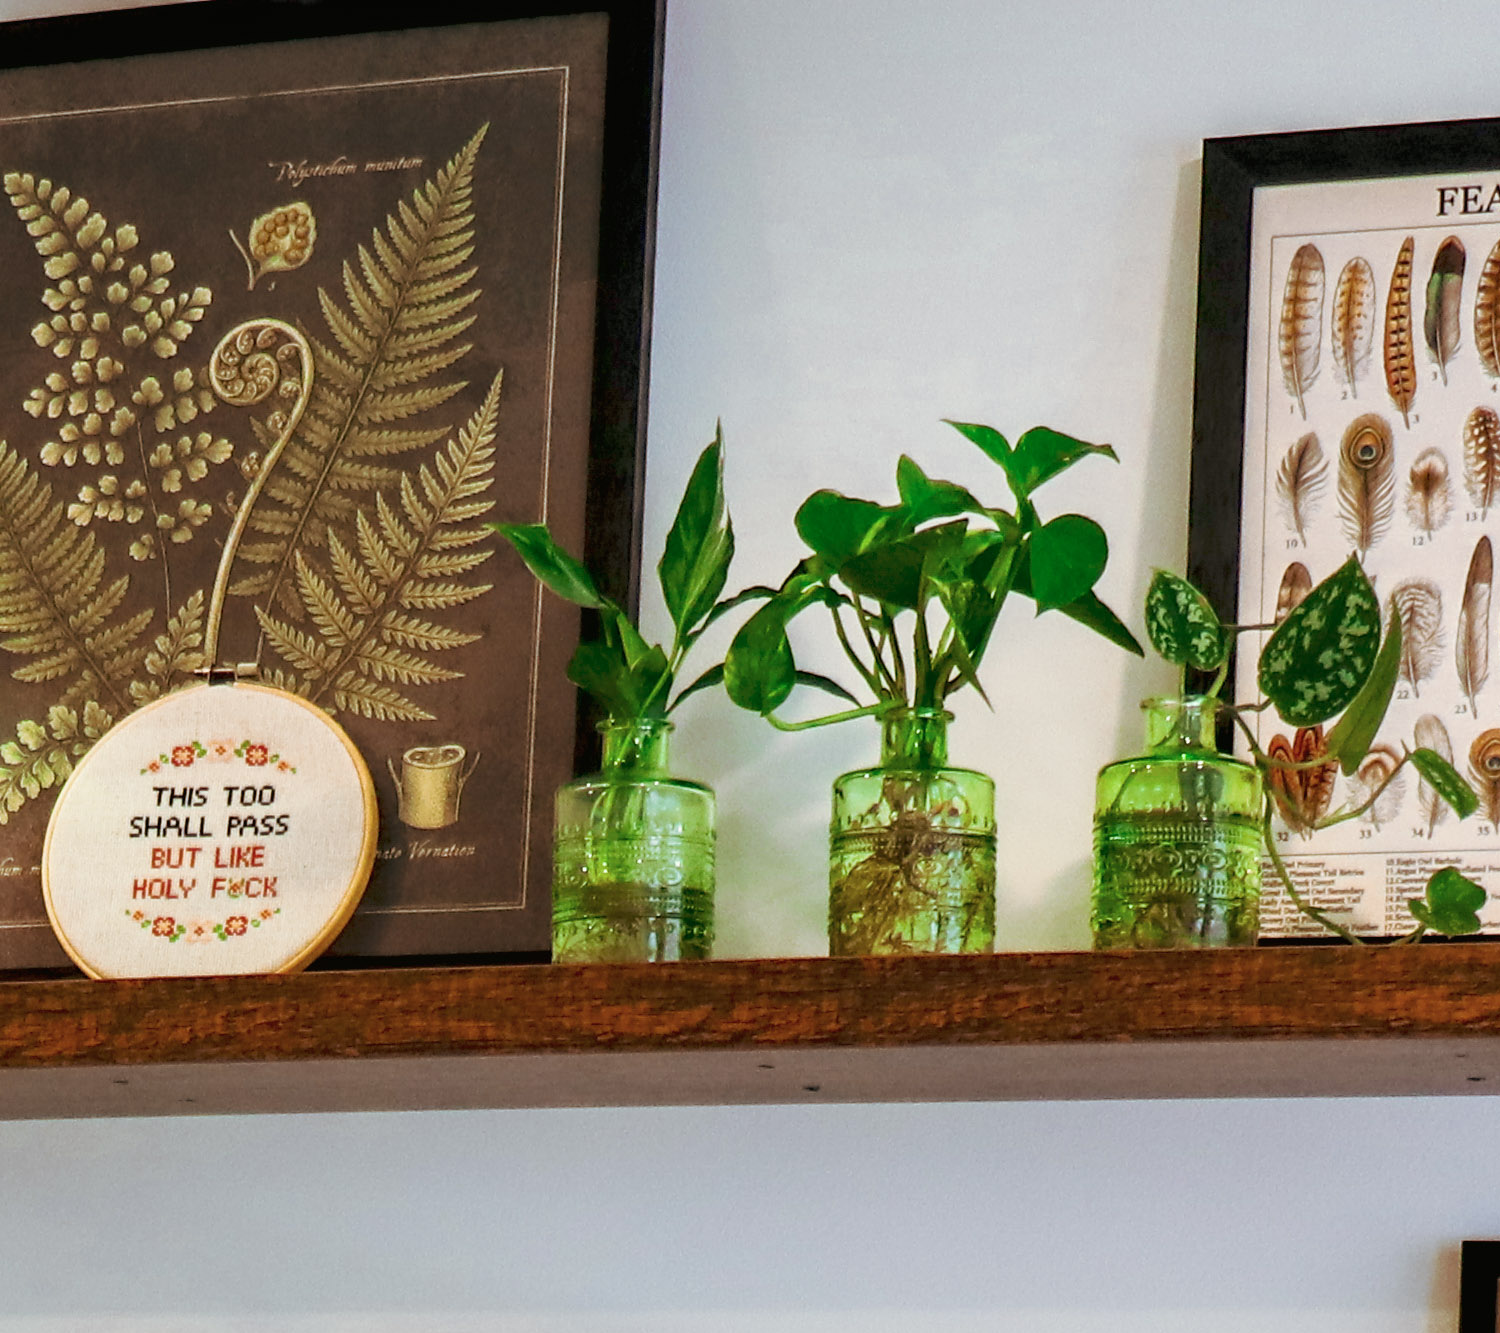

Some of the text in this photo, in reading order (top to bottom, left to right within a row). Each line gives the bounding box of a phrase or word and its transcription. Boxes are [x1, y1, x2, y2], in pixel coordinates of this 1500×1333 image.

[1466, 513, 1478, 522] 13
[1412, 536, 1424, 546] 12
[1396, 690, 1409, 699] 22
[1454, 705, 1467, 713] 23
[152, 785, 276, 807] THIS TOO
[129, 814, 290, 839] SHALL PASS
[1477, 826, 1490, 836] 35
[1276, 831, 1289, 842] 32
[1359, 829, 1372, 839] 33
[1411, 828, 1424, 838] 34
[150, 846, 265, 869] BUT LIKE
[132, 878, 196, 900] HOLY
